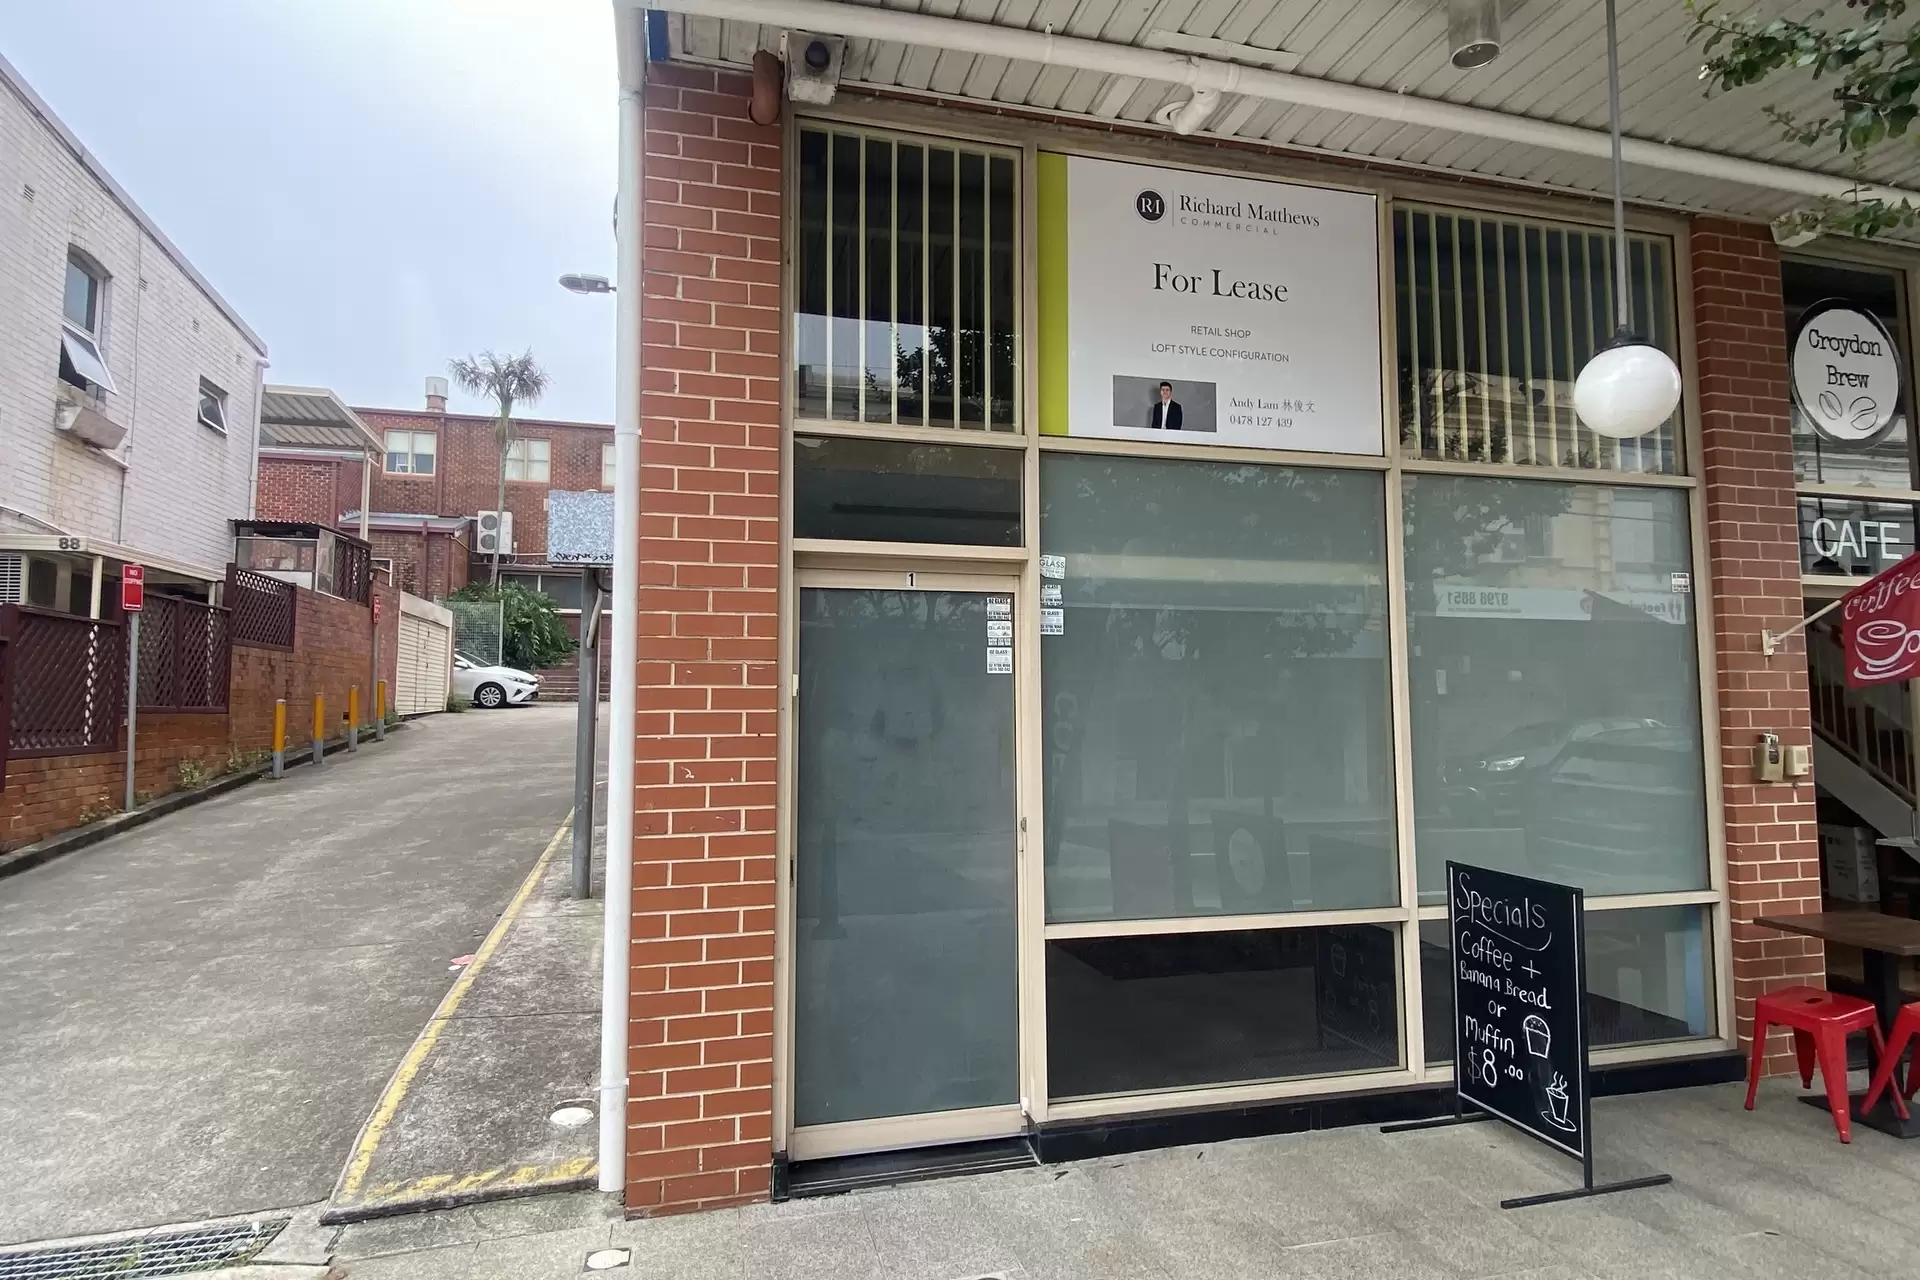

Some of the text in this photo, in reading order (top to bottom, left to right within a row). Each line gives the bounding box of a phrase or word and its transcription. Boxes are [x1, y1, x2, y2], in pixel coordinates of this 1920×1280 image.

[1180, 194, 1320, 228] Richard Matthews
[1180, 216, 1279, 236] COMMERCIAL
[1153, 263, 1289, 303] For Lease
[1190, 325, 1251, 339] RETAIL SHOP
[1808, 328, 1883, 358] Croydon
[1151, 343, 1290, 363] LOFT STYLE CONFIGURATION
[1825, 364, 1870, 389] Brew
[1229, 397, 1255, 410] Andy
[1257, 399, 1279, 410] Lam
[1229, 415, 1253, 426] 0478
[1256, 416, 1273, 427] 127
[59, 537, 80, 549] 88
[1811, 516, 1904, 560] CAFE
[1039, 559, 1065, 569] GLASS
[908, 572, 915, 587] 1
[1844, 572, 1920, 620] Coffee
[1456, 871, 1547, 929] Specials
[1460, 930, 1513, 971] Coffee
[1460, 960, 1552, 1009] Banana Bread
